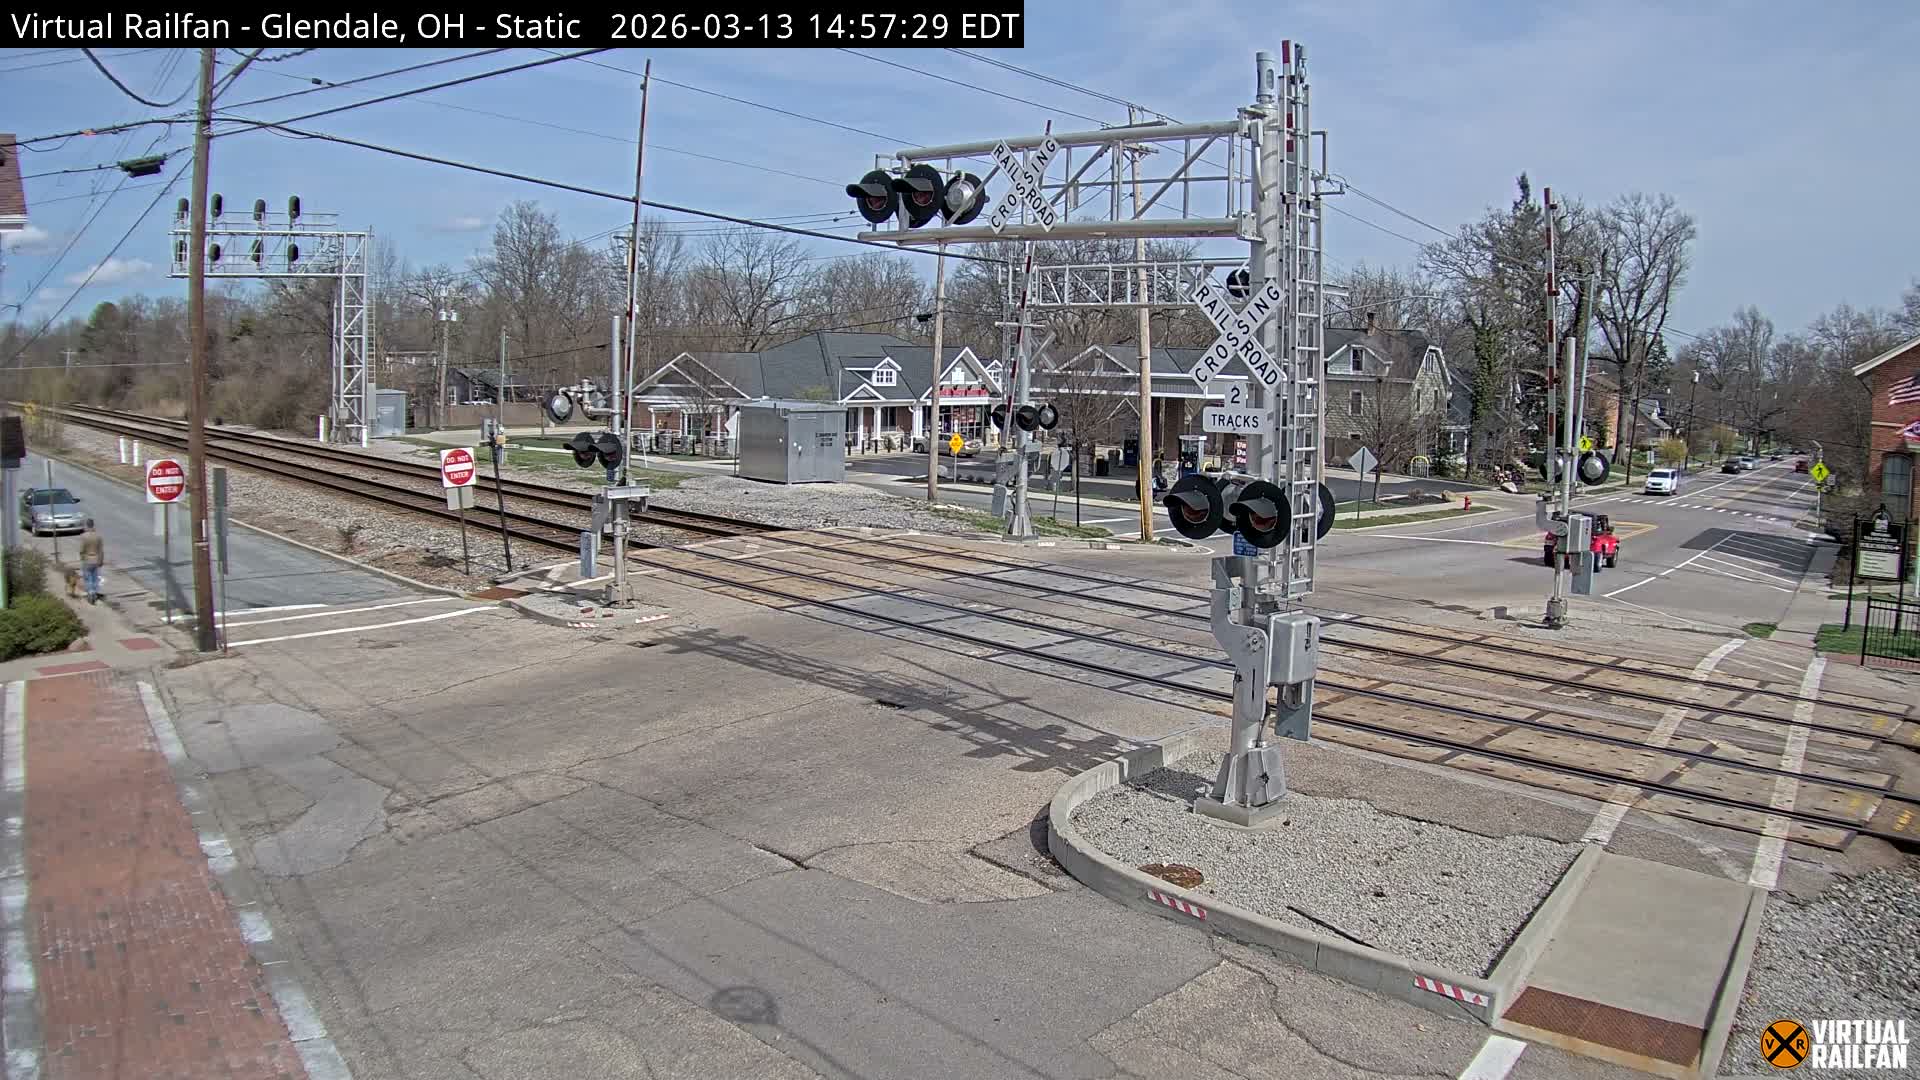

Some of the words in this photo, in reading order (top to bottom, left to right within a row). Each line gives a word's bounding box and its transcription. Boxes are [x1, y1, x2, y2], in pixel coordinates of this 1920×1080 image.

[991, 139, 1056, 228] CROSSING
[993, 144, 1054, 226] RAILROAD
[1195, 285, 1280, 382] CROSSING
[1195, 285, 1278, 385] RAILROAD
[1230, 387, 1241, 404] 2
[1211, 414, 1259, 428] TRACKS
[152, 468, 161, 476] DO
[165, 467, 178, 475] NOT
[450, 471, 469, 480] ENTER
[155, 486, 177, 494] ENTER
